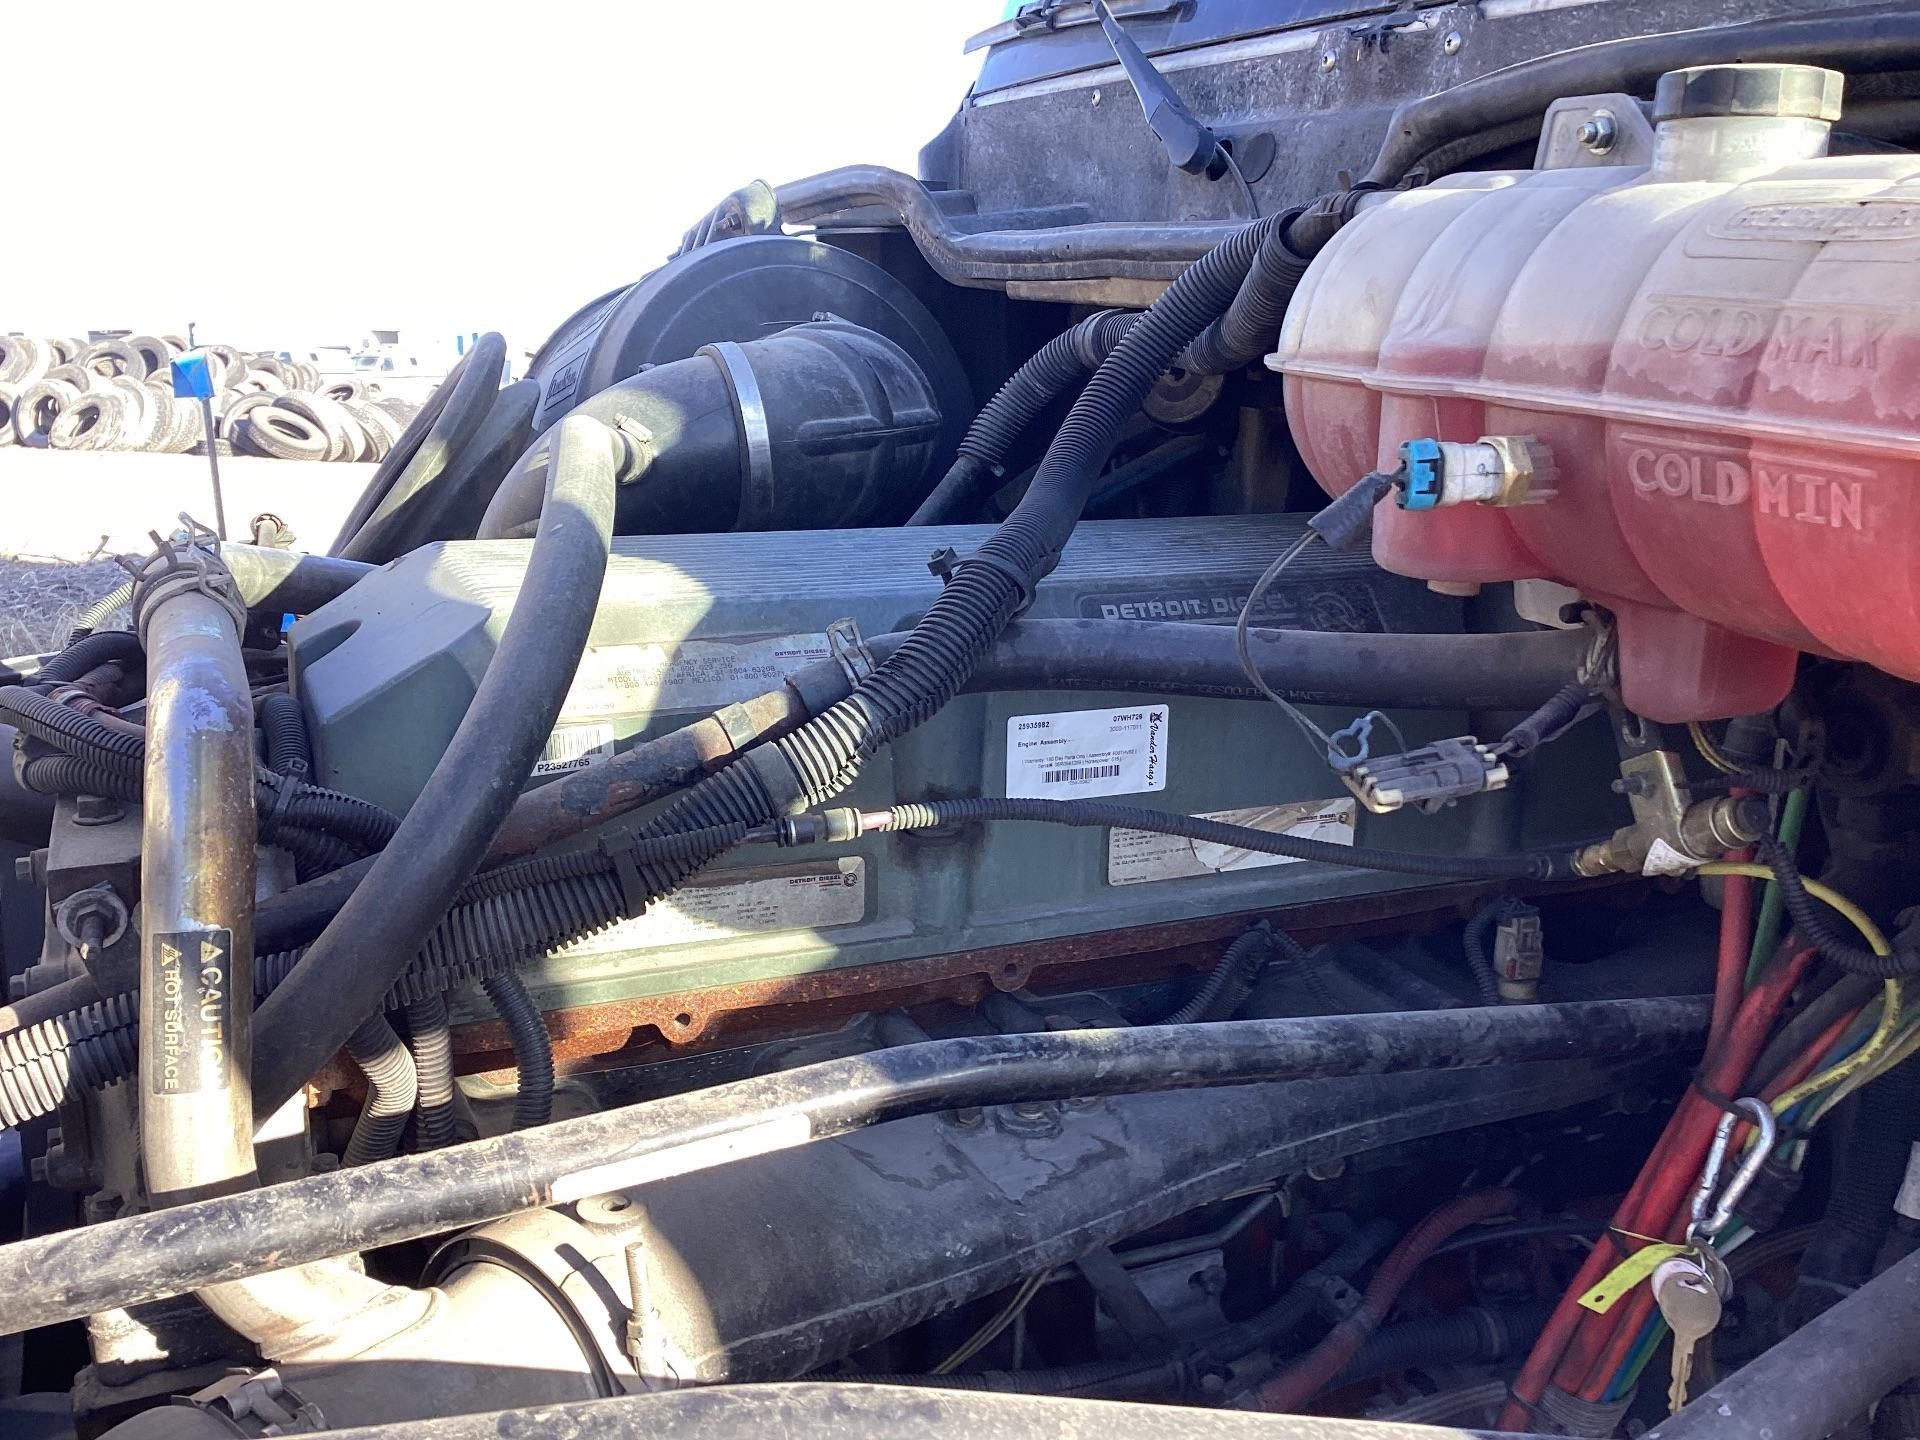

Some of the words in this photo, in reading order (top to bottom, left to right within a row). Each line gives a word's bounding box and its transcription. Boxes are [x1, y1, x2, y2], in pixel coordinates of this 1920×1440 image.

[1640, 306, 1766, 357] COLD
[1770, 313, 1896, 368] MAX
[1627, 448, 1751, 506] COLD
[1757, 470, 1863, 530] MIN
[1101, 598, 1200, 620] DETROIT
[1211, 593, 1296, 613] DIESEL
[538, 758, 590, 772] P23527765
[1017, 740, 1038, 749] Engine
[1040, 738, 1068, 746] Assembly
[164, 969, 180, 1002] HOT
[164, 1010, 180, 1090] SURFACE
[200, 966, 223, 1088] CAUTIO
